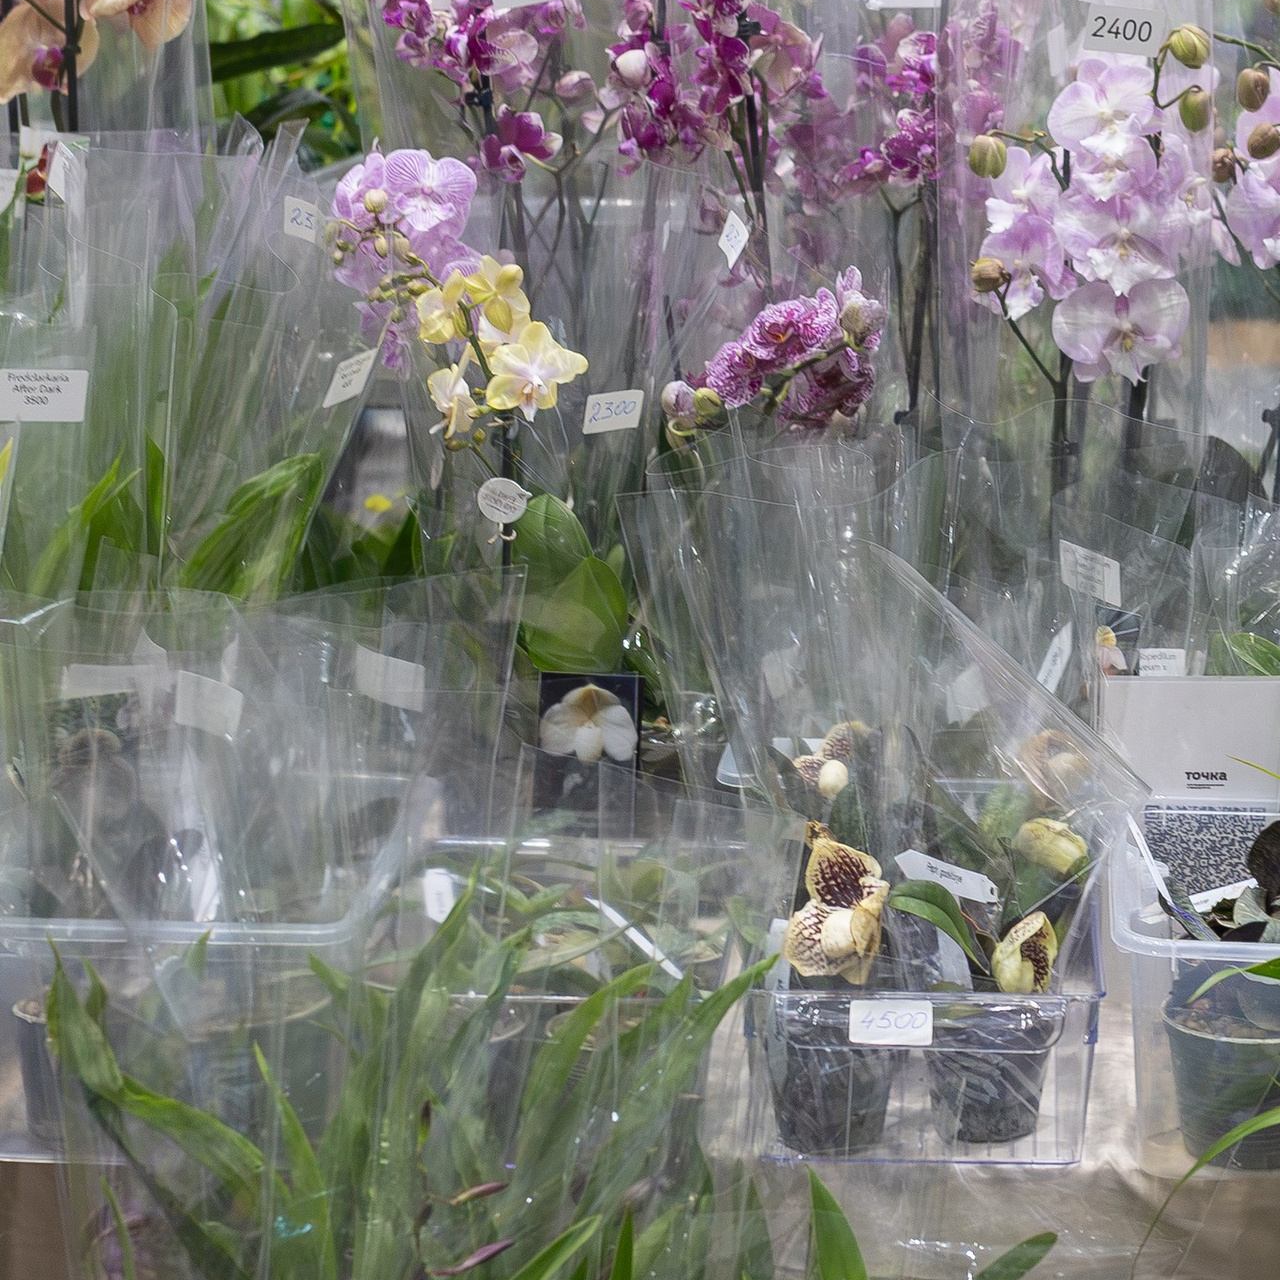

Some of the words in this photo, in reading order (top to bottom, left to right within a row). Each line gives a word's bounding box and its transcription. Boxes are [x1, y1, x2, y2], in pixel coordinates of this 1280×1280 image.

[1090, 16, 1153, 42] 2400
[588, 399, 638, 423] 2300
[1185, 770, 1228, 782] точка
[859, 1009, 928, 1030] 4500
